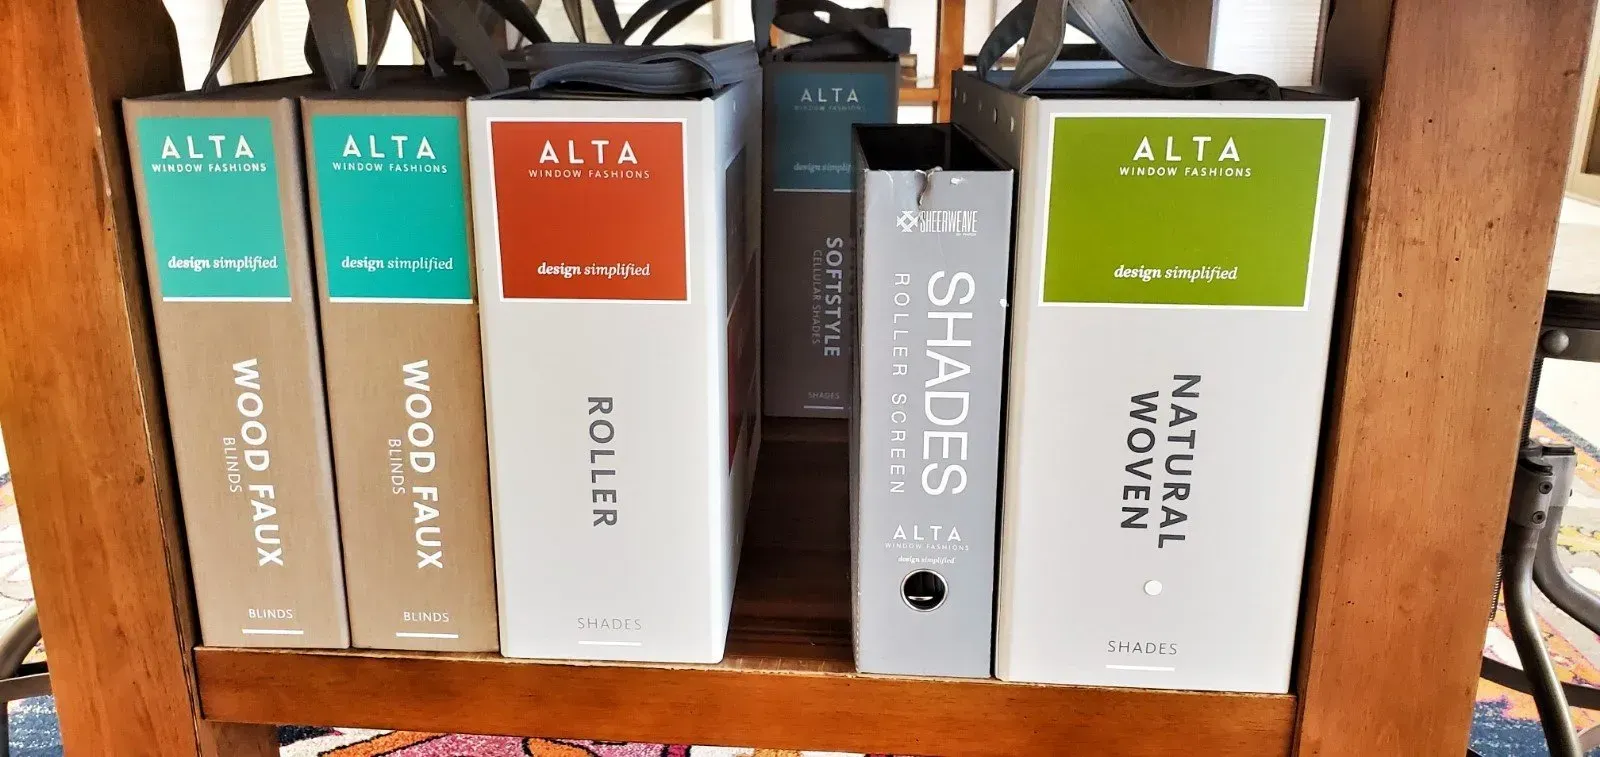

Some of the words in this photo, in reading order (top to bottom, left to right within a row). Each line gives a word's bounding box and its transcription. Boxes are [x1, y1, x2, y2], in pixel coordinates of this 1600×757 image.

[801, 87, 859, 102] ALTA
[161, 135, 255, 159] ALTA
[343, 134, 436, 160] ALTA
[539, 139, 637, 164] ALTA
[1133, 135, 1240, 162] ALTA
[152, 164, 202, 173] WINDOW
[208, 163, 267, 172] FASHIONS
[332, 162, 383, 171] WINDOW
[389, 163, 448, 173] FASHIONS
[528, 169, 582, 178] WINDOW
[589, 170, 650, 179] FASHIONS
[1119, 166, 1178, 176] WINDOW
[1184, 167, 1252, 177] FASHIONS
[920, 210, 978, 233] SHEERWEAVE
[167, 256, 211, 271] design
[213, 256, 278, 271] simplified
[341, 256, 385, 271] design
[388, 256, 453, 272] simplified
[537, 262, 582, 278] design
[584, 263, 650, 279] simplified
[812, 250, 822, 301] CELLULAR
[1114, 264, 1162, 282] design
[1165, 265, 1238, 283] simplified
[824, 237, 844, 357] SOFTSTYLE
[812, 305, 821, 345] SHADES
[892, 273, 910, 376] ROLLER
[921, 270, 975, 496] SHADES
[808, 391, 840, 400] SHADES
[232, 358, 270, 472] WOOD
[402, 359, 436, 474] WOOD
[890, 393, 907, 493] SCREEN
[223, 436, 242, 493] BLINDS
[388, 438, 405, 495] BLINDS
[587, 396, 618, 527] ROLLER
[1120, 390, 1159, 529] WOVEN
[1157, 374, 1201, 549] NATURAL
[249, 484, 284, 567] FAUX
[412, 486, 443, 569] FAUX
[892, 524, 961, 542] ALTA
[926, 543, 969, 551] FASHIONS
[898, 556, 920, 564] design
[921, 556, 955, 564] simplified
[249, 608, 293, 619] BLINDS
[403, 611, 449, 622] BLINDS
[577, 617, 642, 630] SHADES
[1107, 640, 1178, 655] SHADES
